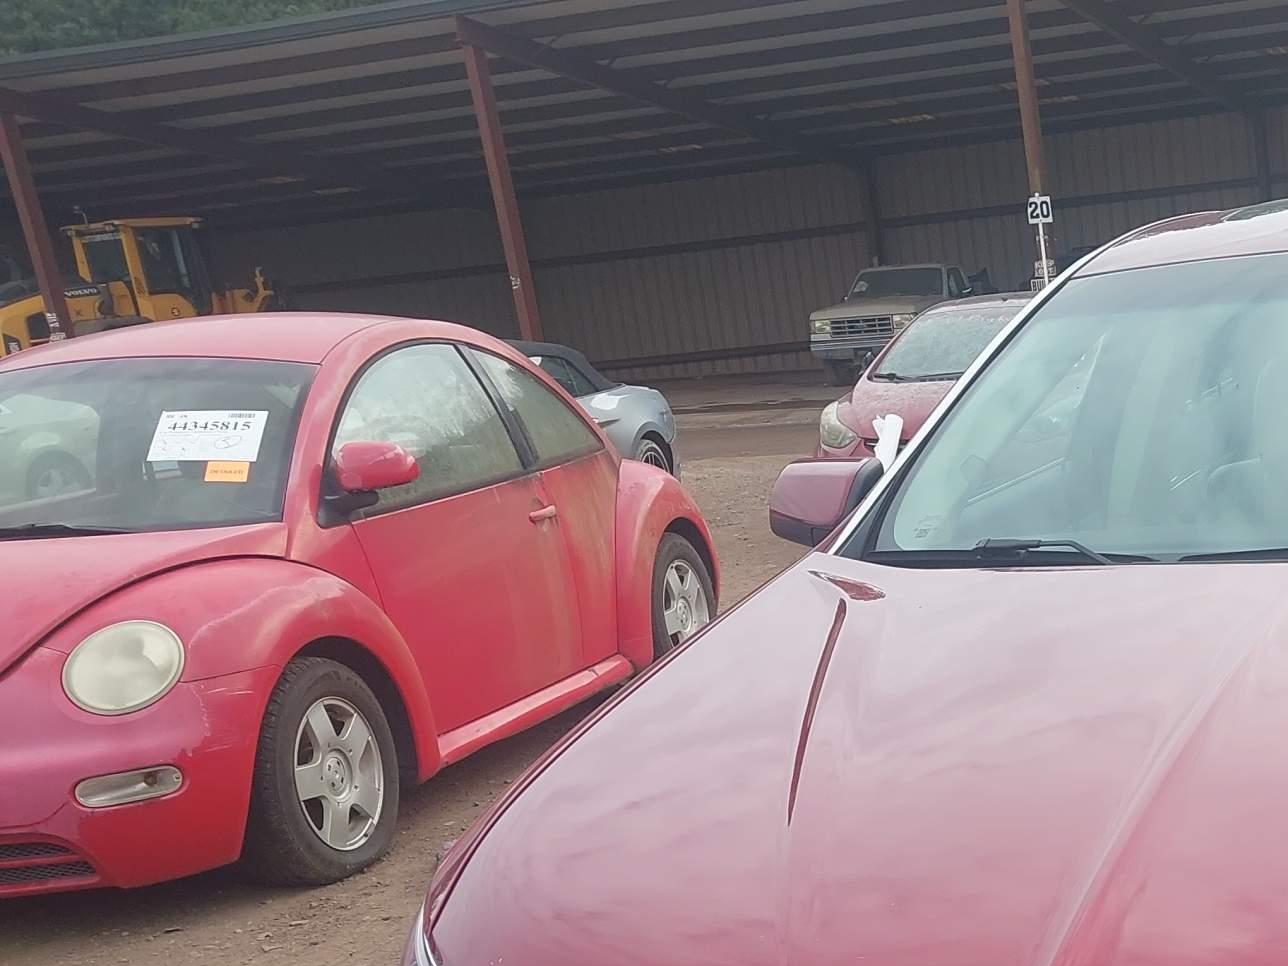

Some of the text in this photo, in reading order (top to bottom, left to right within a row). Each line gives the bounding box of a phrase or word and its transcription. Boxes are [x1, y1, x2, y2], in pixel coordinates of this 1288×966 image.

[1028, 200, 1050, 219] 20
[64, 287, 98, 297] VOLVO
[167, 421, 252, 431] 44345815
